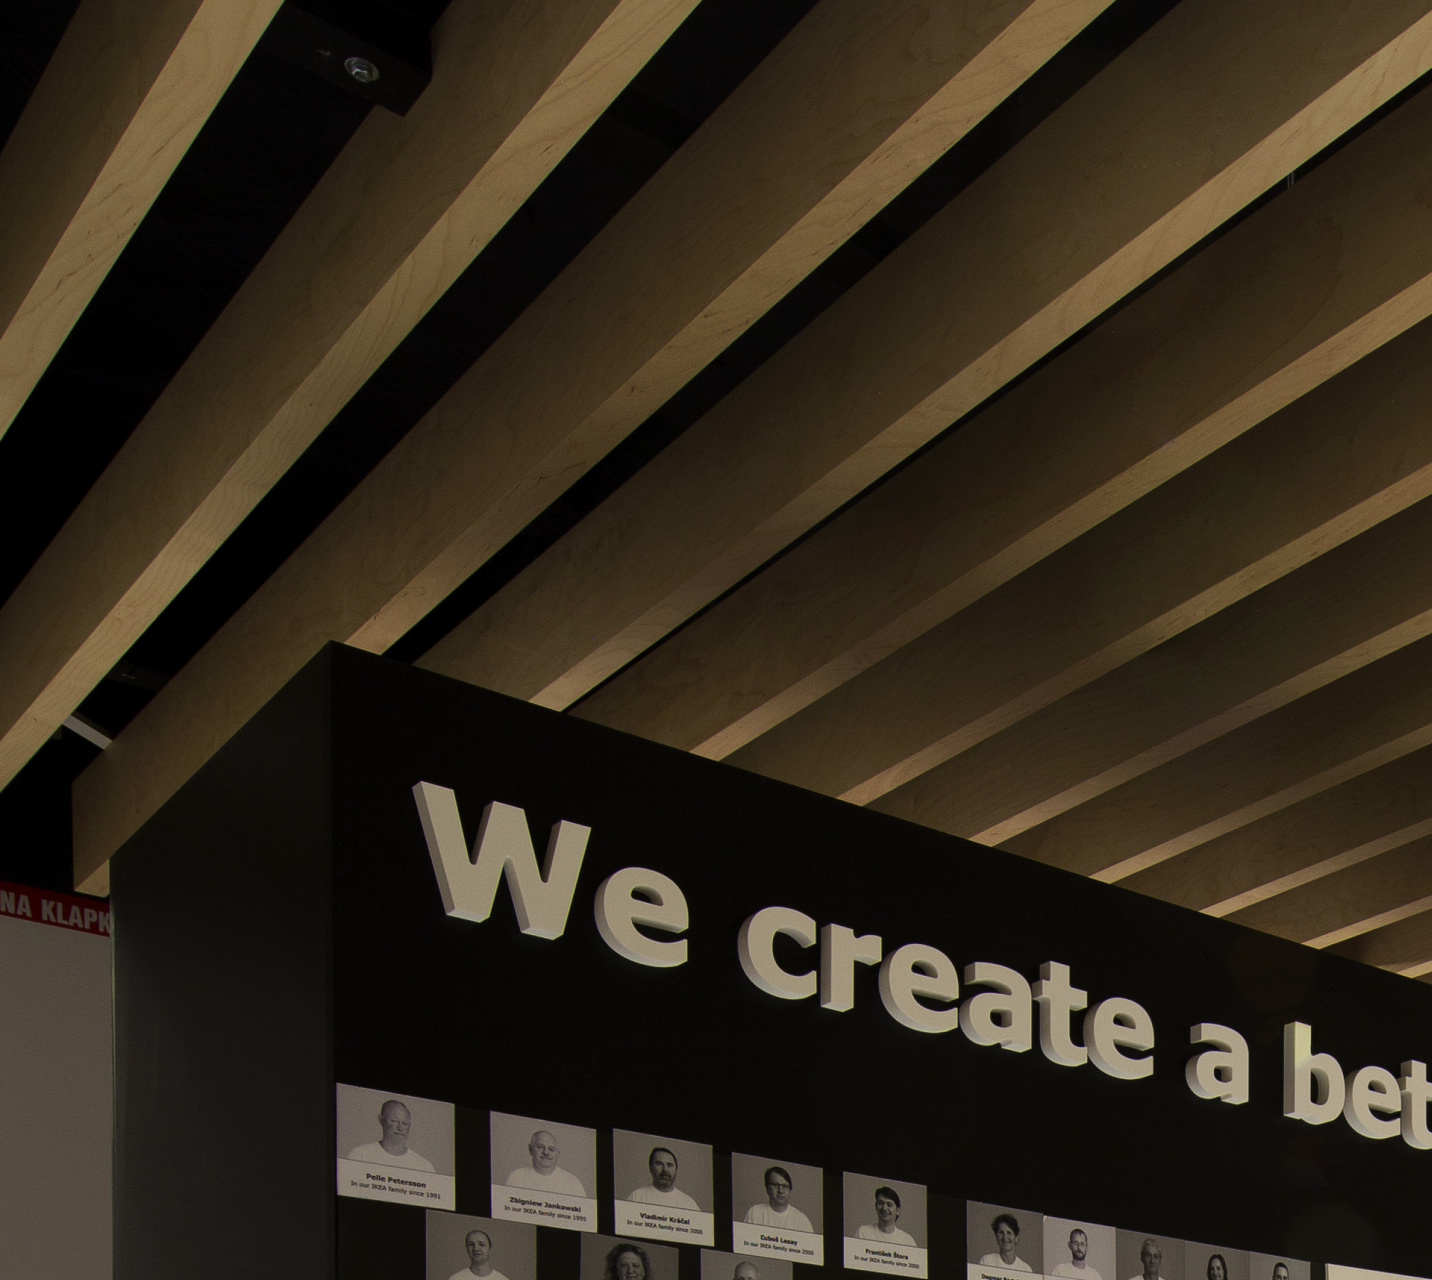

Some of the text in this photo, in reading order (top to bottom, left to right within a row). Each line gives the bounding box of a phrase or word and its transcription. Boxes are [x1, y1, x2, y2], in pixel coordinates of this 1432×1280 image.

[411, 779, 690, 968] We
[737, 905, 1155, 1081] create
[1184, 1022, 1250, 1106] a
[366, 1173, 426, 1188] Pelle Petersson
[371, 1183, 387, 1191] IKEA
[388, 1185, 407, 1195] family
[408, 1189, 424, 1197] since
[509, 1196, 581, 1213] Zbigniew Jankowski
[523, 1207, 537, 1215] IKEA
[538, 1209, 555, 1218] family
